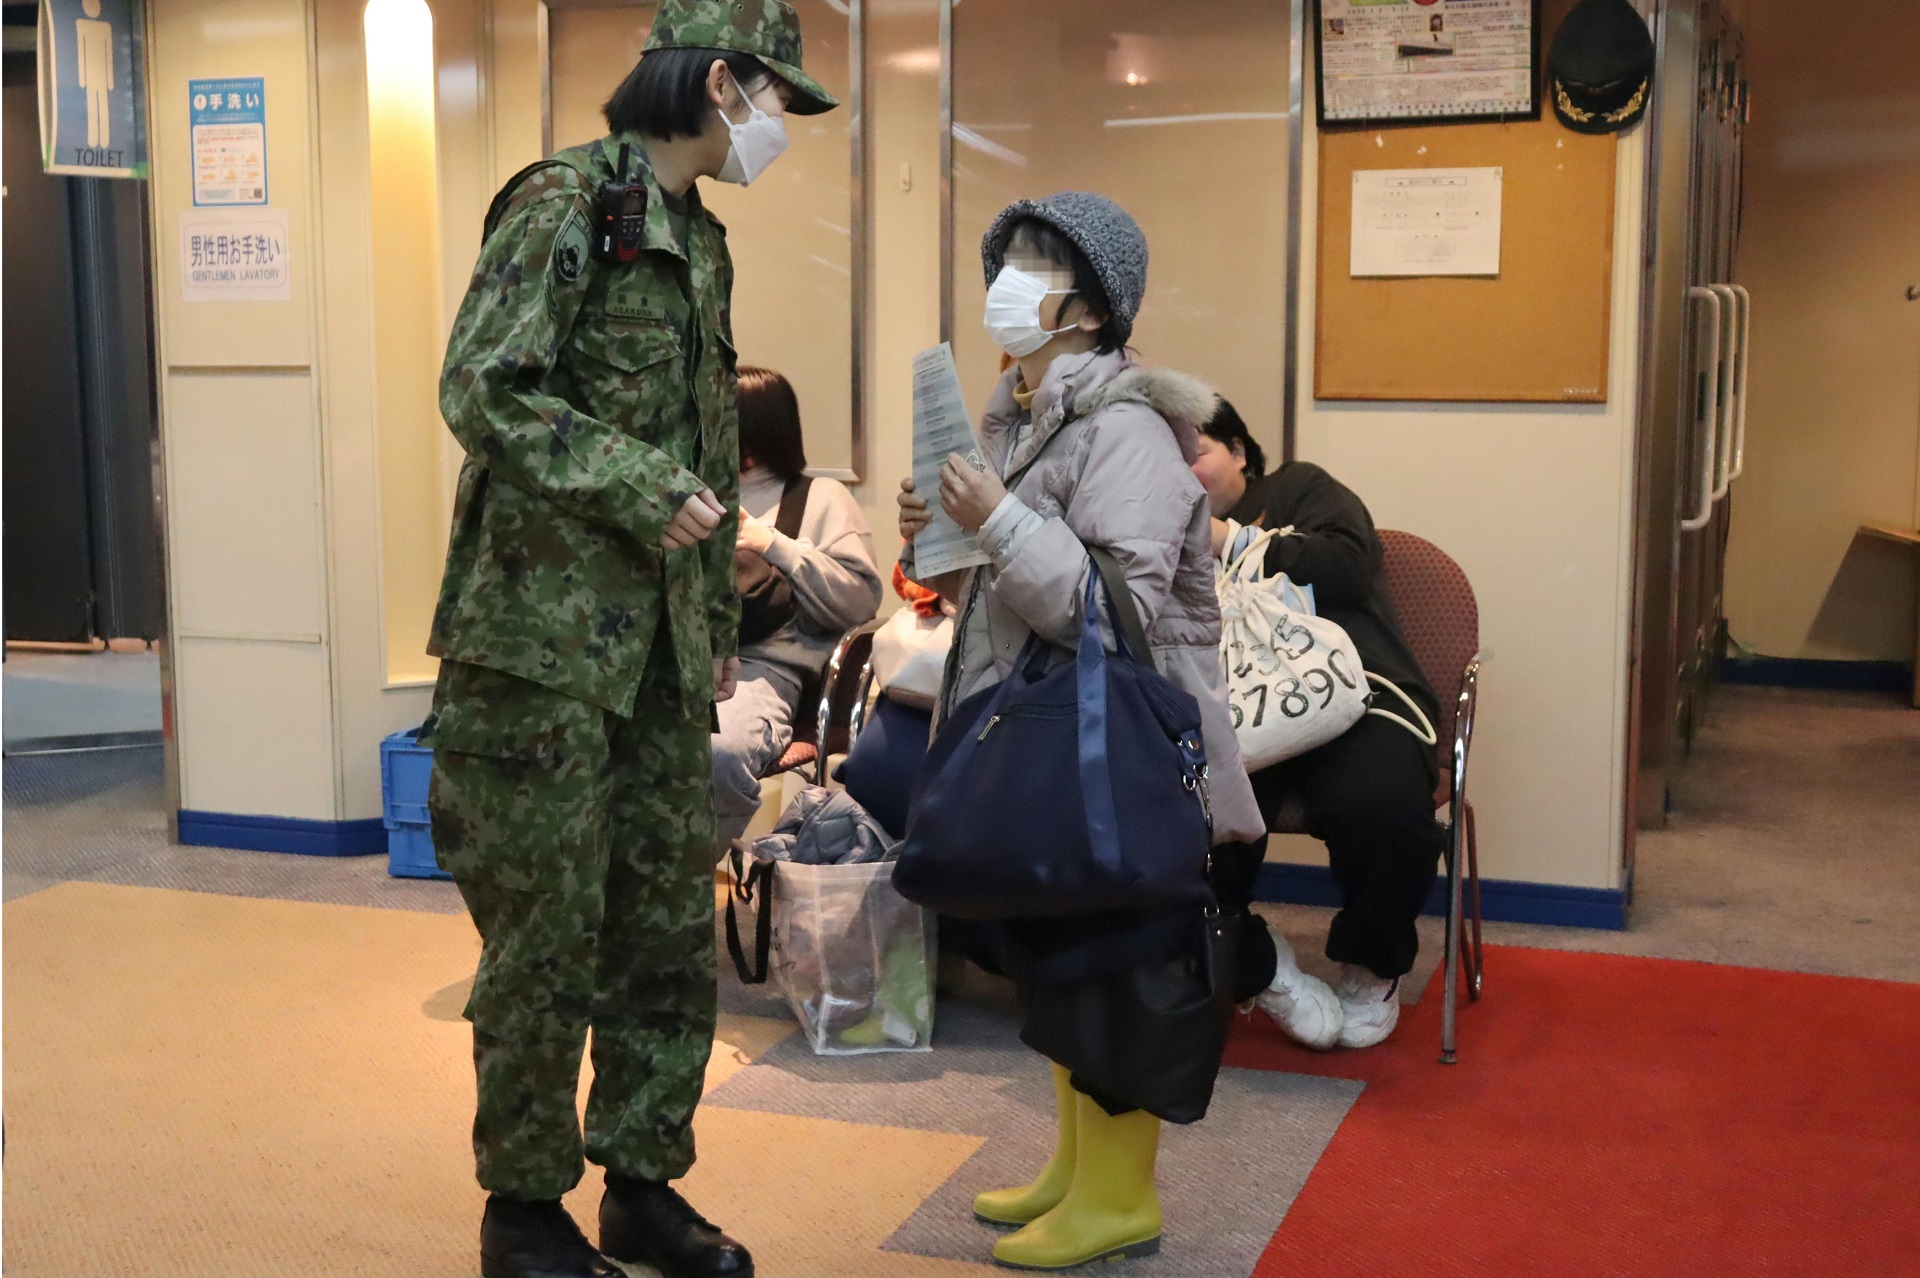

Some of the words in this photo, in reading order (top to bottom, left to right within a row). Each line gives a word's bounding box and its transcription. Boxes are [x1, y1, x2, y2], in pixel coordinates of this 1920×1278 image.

[210, 93, 260, 110] 手洗い
[75, 147, 124, 168] TOILET
[191, 234, 280, 267] 男性用お手洗い
[192, 269, 236, 281] GENTLEMEN
[240, 268, 279, 280] LAVATORY
